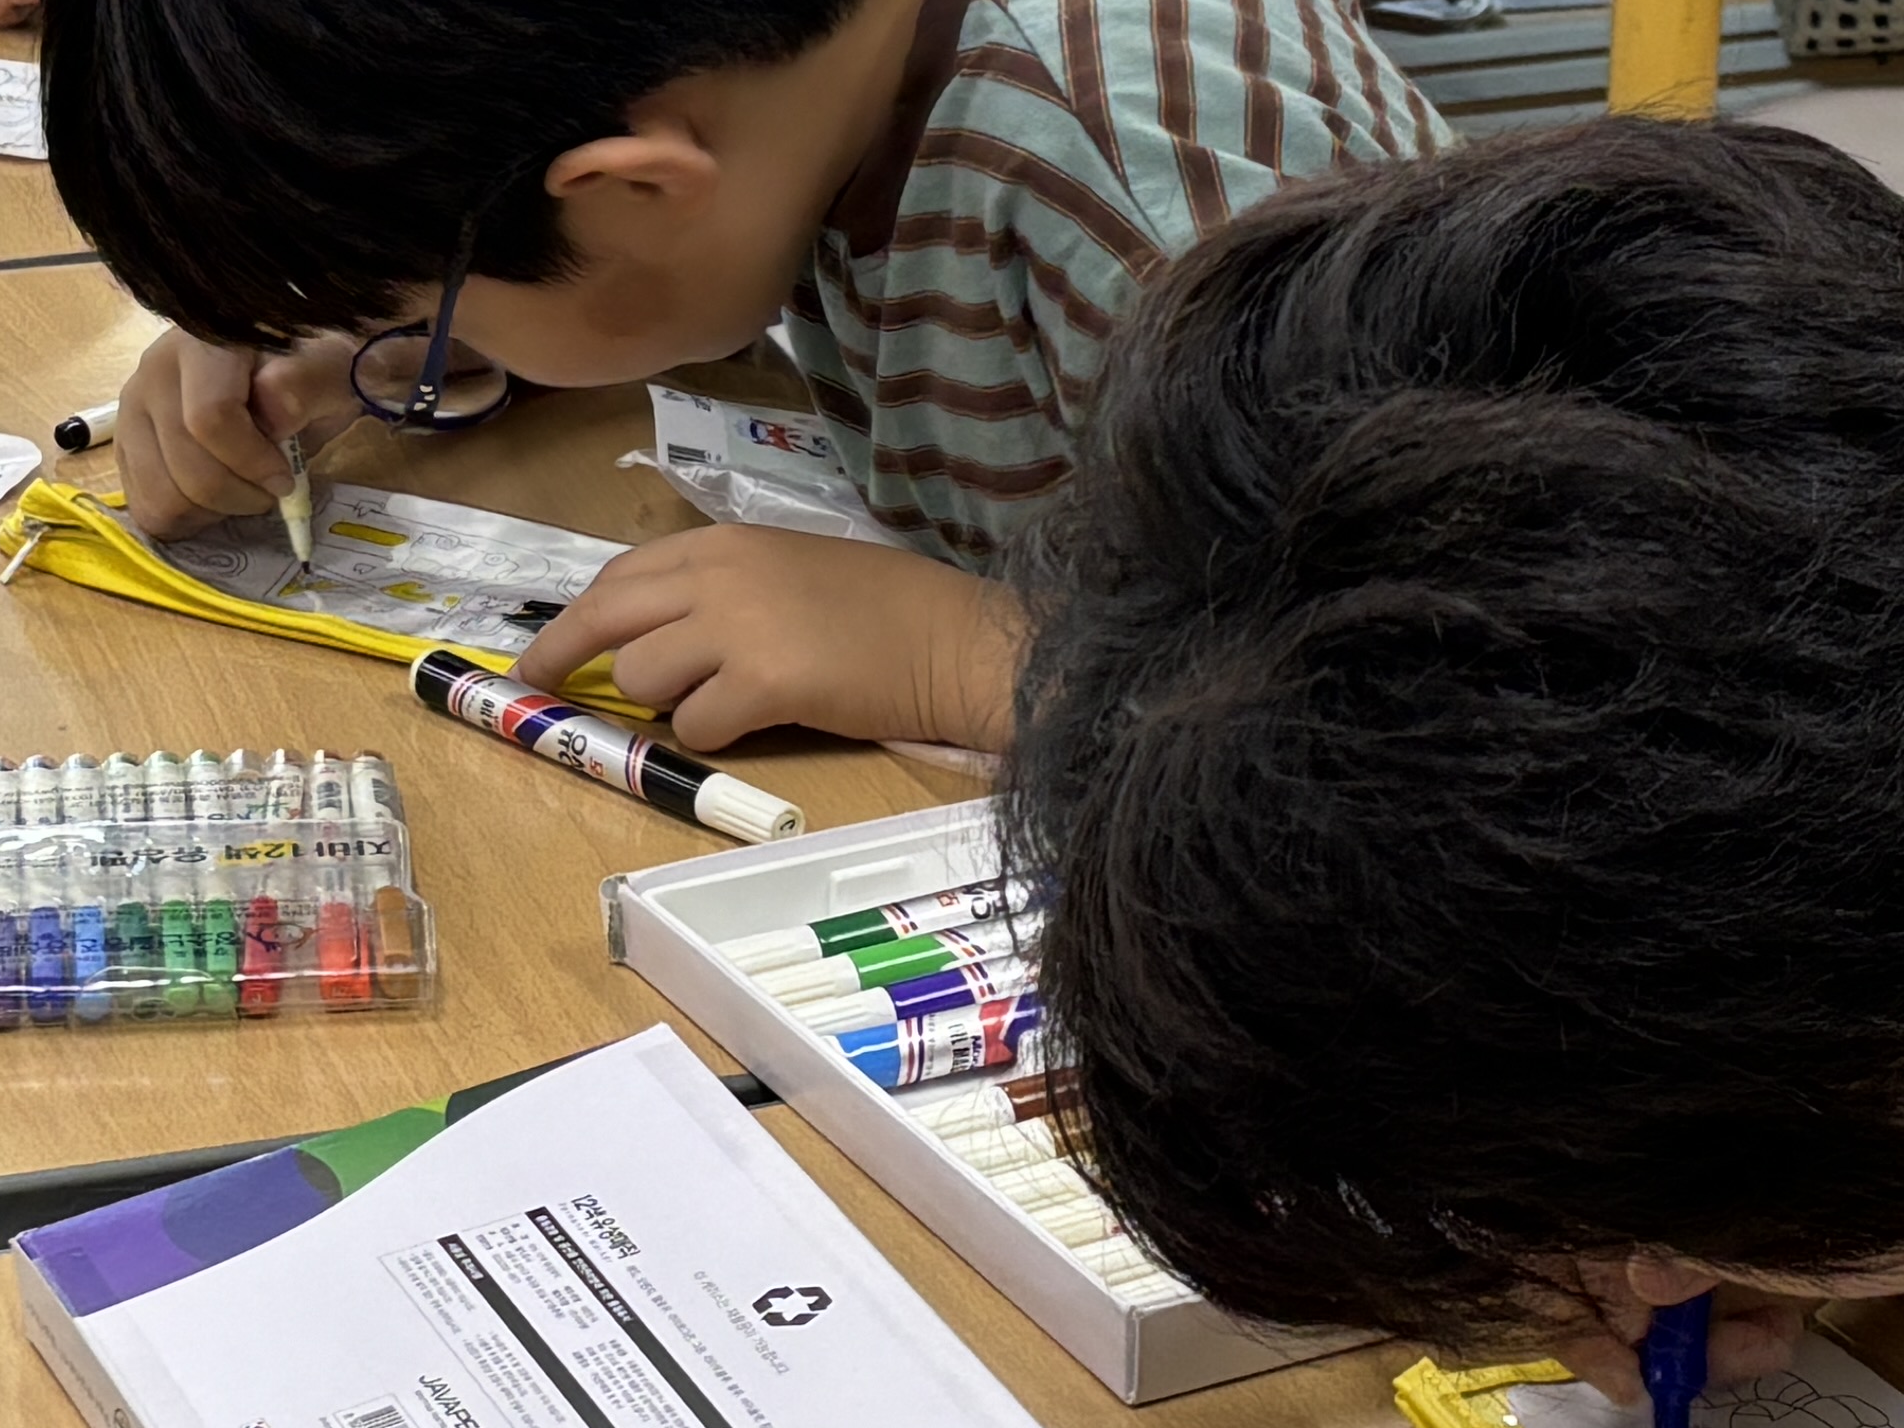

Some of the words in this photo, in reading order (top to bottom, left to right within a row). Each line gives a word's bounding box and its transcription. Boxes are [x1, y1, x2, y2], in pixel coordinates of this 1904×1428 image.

[223, 841, 301, 861] 12색
[315, 839, 390, 856] 자바
[568, 1193, 608, 1221] 12색
[587, 1215, 642, 1260] 유성매직
